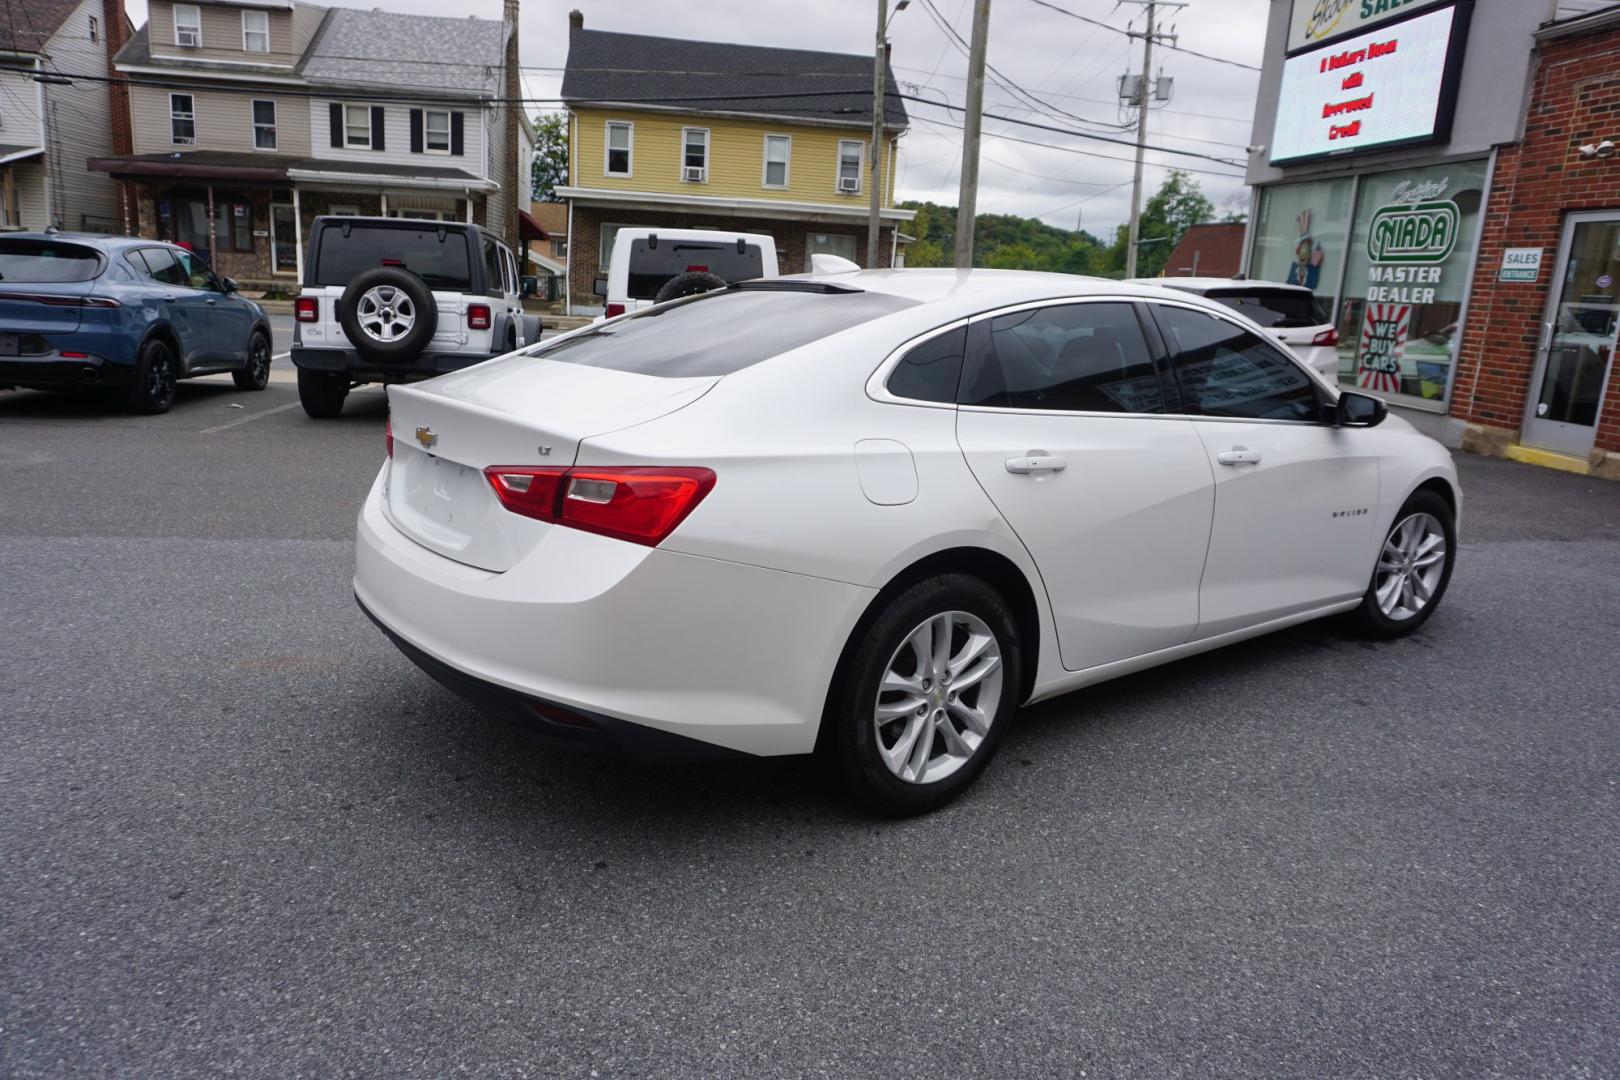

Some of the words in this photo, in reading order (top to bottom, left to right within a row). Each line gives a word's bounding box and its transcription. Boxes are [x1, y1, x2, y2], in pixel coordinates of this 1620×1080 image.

[1328, 48, 1367, 71] Dollars
[1367, 39, 1398, 60] Down
[1341, 71, 1364, 90] with
[1329, 119, 1361, 140] Credit
[1375, 213, 1450, 256] NIADA
[1506, 252, 1539, 265] SALES
[1368, 266, 1442, 283] MASTER
[1502, 269, 1537, 280] ENTRANCE
[1367, 285, 1436, 304] DEALER
[1375, 320, 1397, 337] WE
[1369, 337, 1397, 355] BUY
[1363, 353, 1398, 372] CARS
[537, 446, 552, 456] LT
